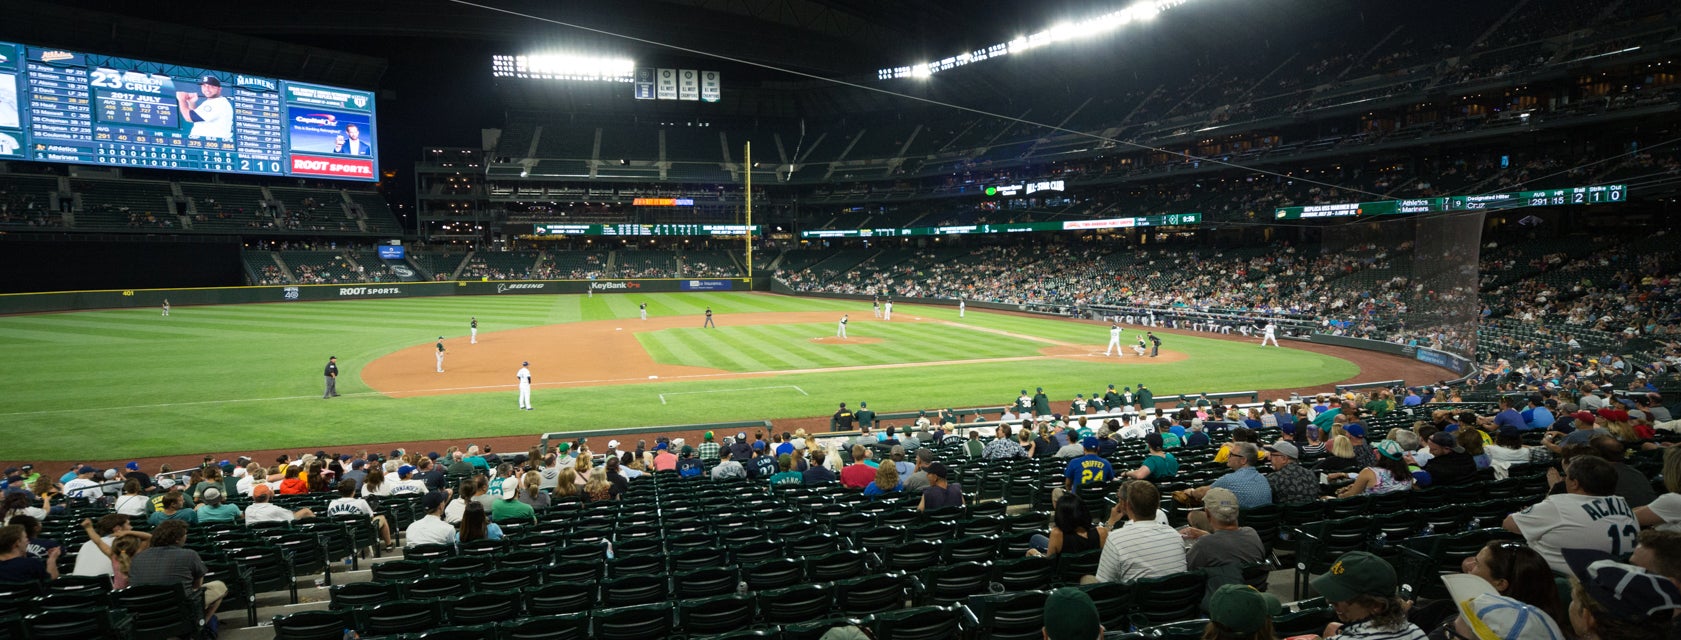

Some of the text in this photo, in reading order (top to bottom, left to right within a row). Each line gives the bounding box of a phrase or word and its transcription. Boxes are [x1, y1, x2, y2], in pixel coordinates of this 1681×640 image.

[91, 72, 162, 88] 23 NELSON
[237, 75, 274, 90] MARINERS
[125, 83, 160, 93] CRUZ
[241, 160, 280, 172] 2 1 0
[294, 160, 329, 170] ROOT
[1050, 180, 1064, 191] CLUB
[1575, 194, 1582, 202] 2
[1594, 193, 1599, 201] 1
[1612, 191, 1619, 200] 0
[339, 288, 367, 296] ROOT
[1081, 460, 1104, 469] GRIFFEY
[1081, 469, 1104, 484] 24
[1608, 524, 1636, 557] 13
[1330, 560, 1345, 575] A's
